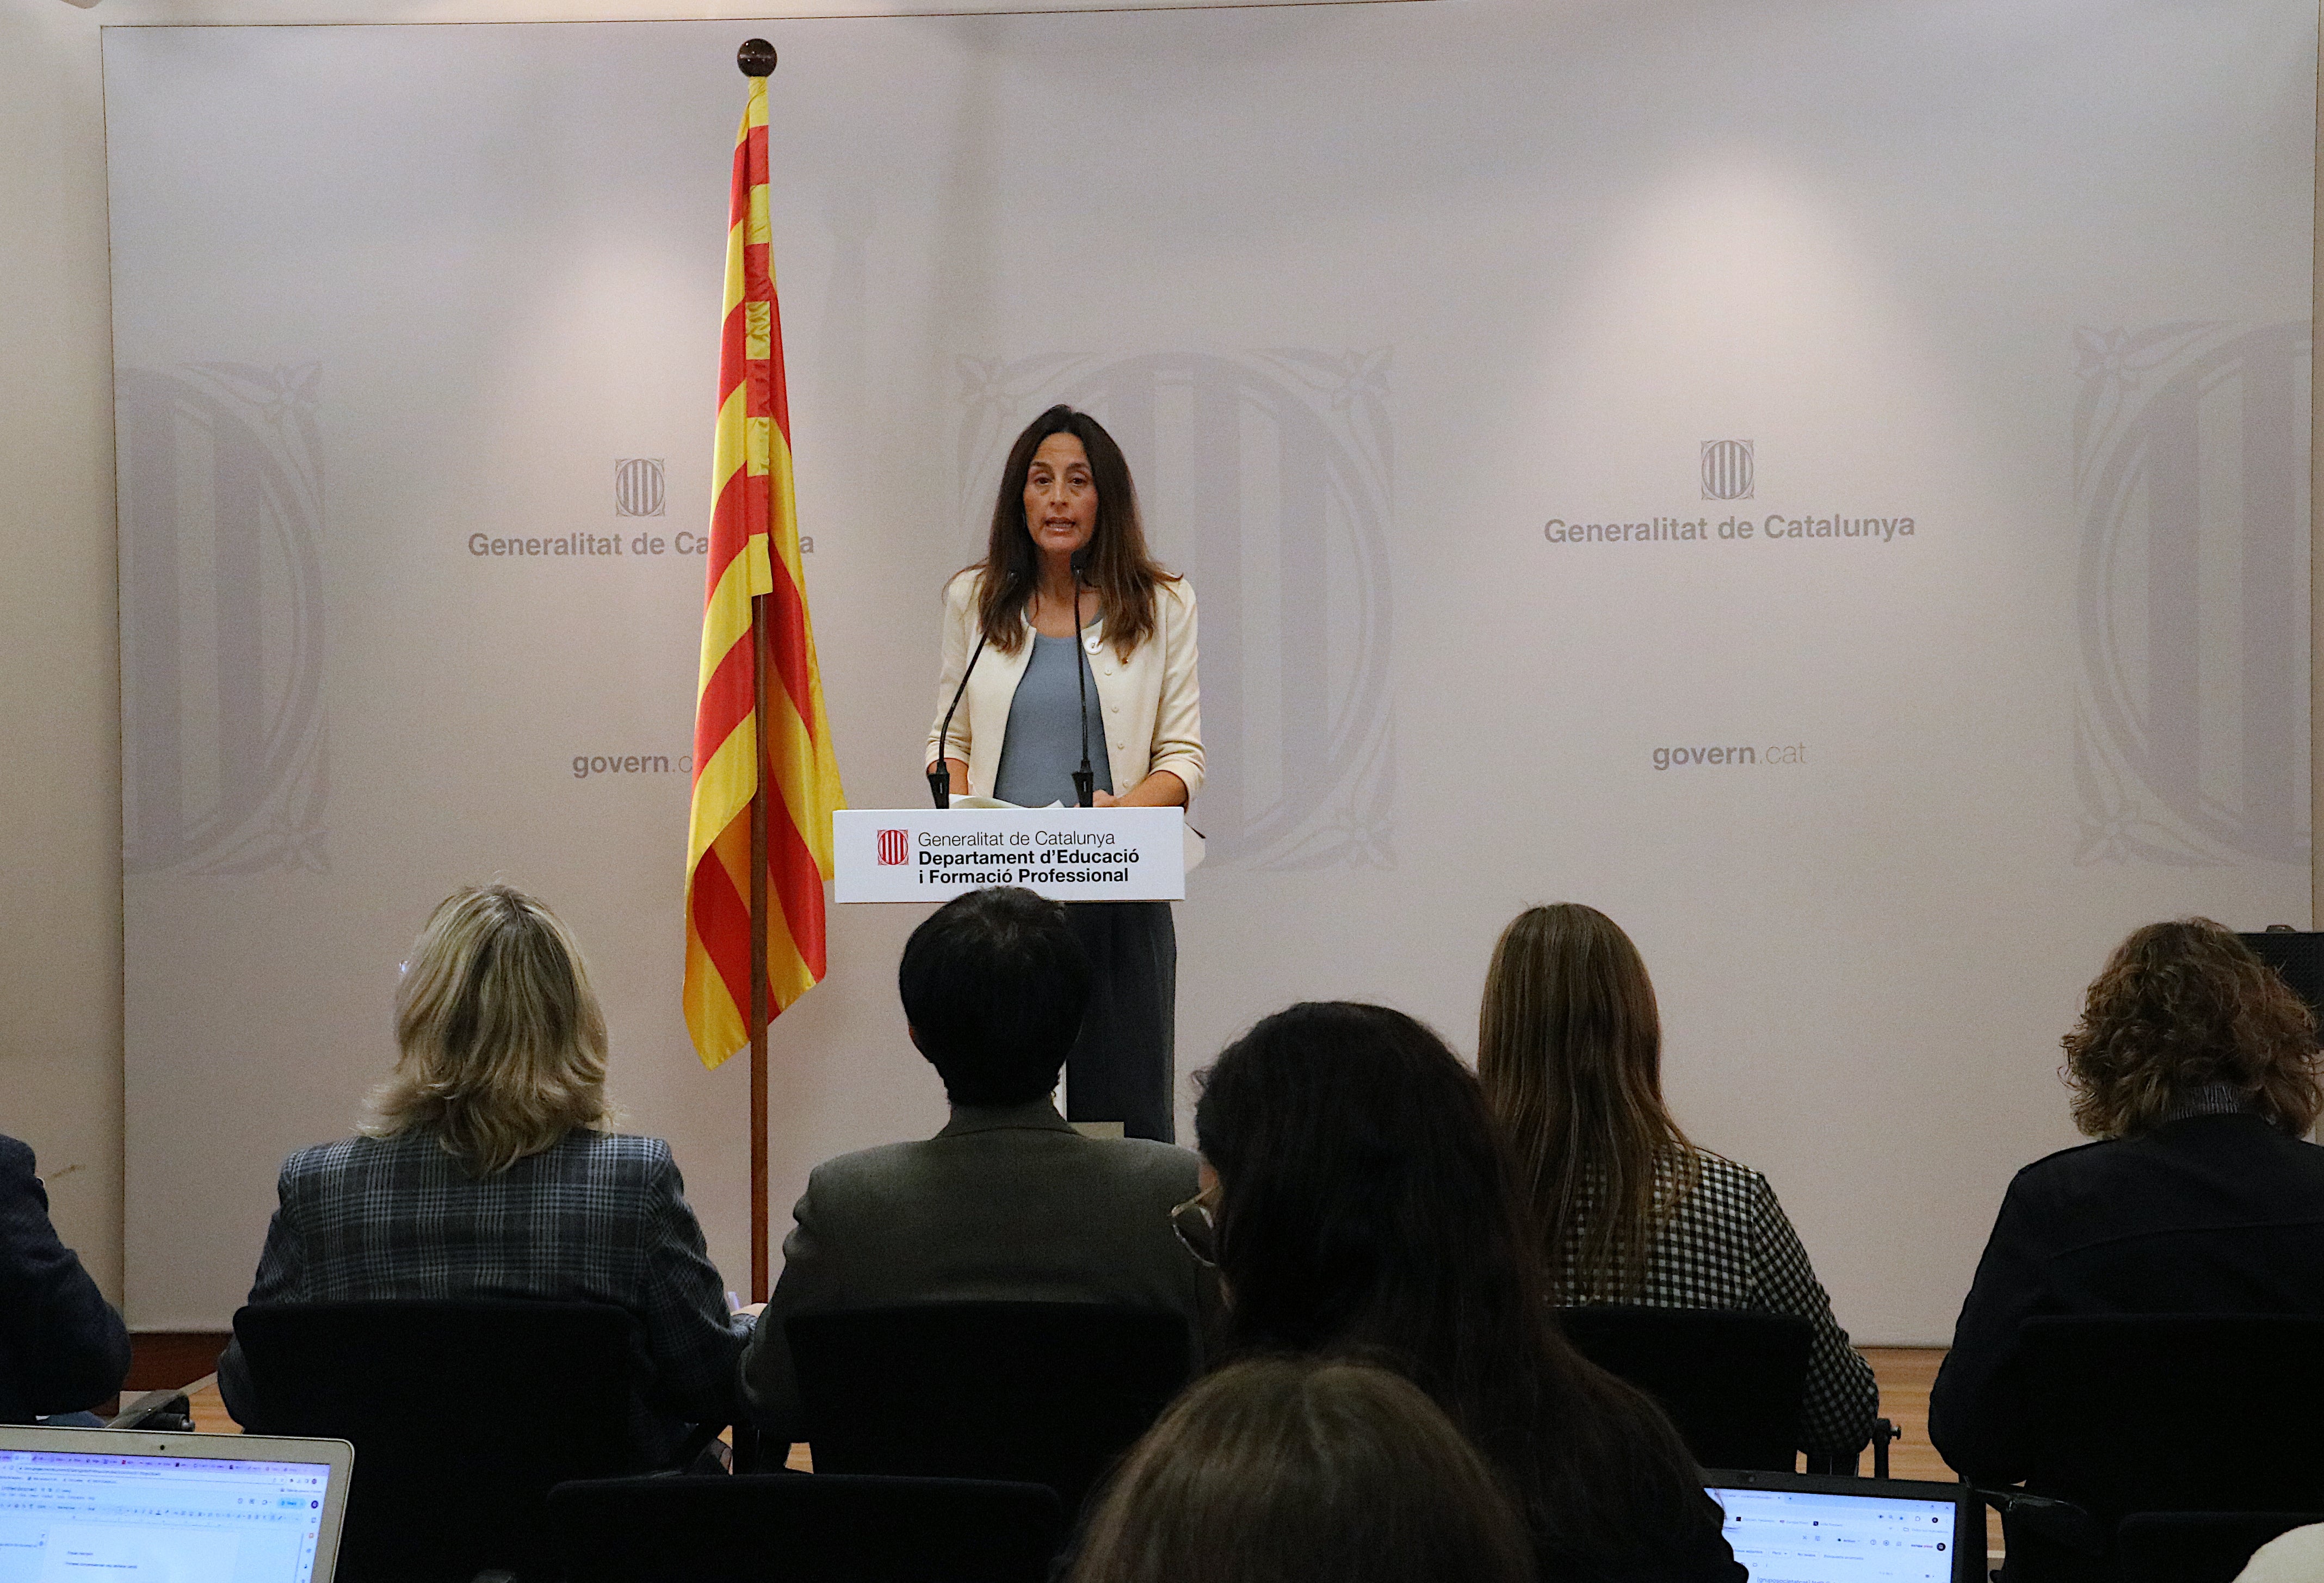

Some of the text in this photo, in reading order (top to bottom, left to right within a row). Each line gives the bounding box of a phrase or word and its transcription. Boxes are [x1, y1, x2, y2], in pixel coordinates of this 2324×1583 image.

[1544, 513, 1915, 543] Generalitat de Catalunya
[468, 532, 622, 556] Generalitat
[631, 532, 665, 555] de
[1653, 741, 1806, 770] govern.cat
[572, 756, 693, 778] govern.c
[918, 831, 1115, 848] Generalitat de Catalunya
[919, 850, 1035, 868] Departament
[919, 868, 1128, 883] i Formació Professional
